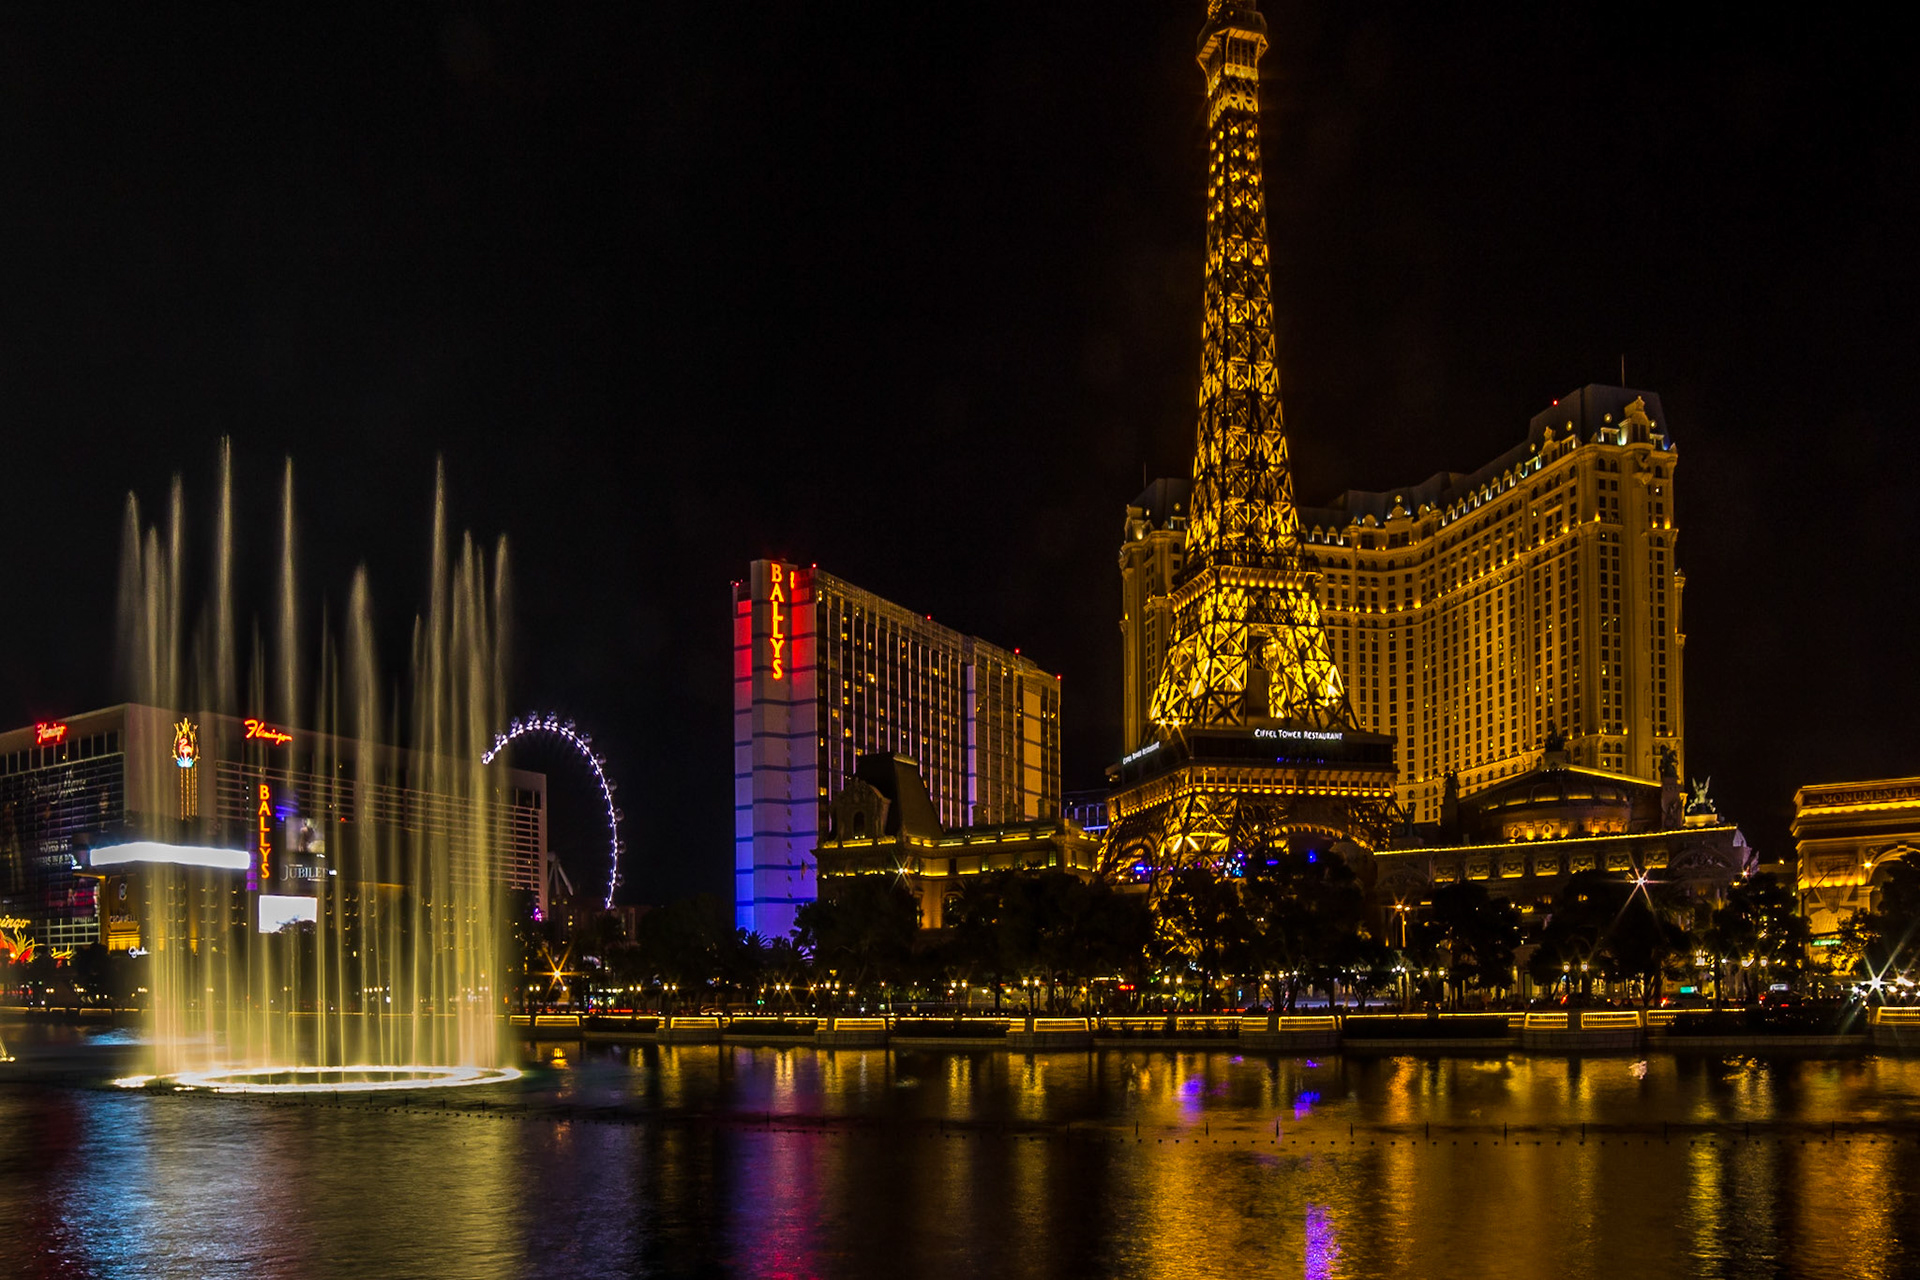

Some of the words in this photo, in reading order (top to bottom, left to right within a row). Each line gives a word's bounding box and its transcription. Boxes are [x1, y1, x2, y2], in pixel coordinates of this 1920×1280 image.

[770, 563, 784, 680] BALLYS
[37, 724, 67, 744] Flamingo
[244, 719, 292, 745] Flamingo
[1278, 729, 1301, 739] TOWER
[1303, 730, 1343, 740] RESTAURANT
[258, 784, 271, 879] BALLYS
[0, 914, 31, 935] ingo
